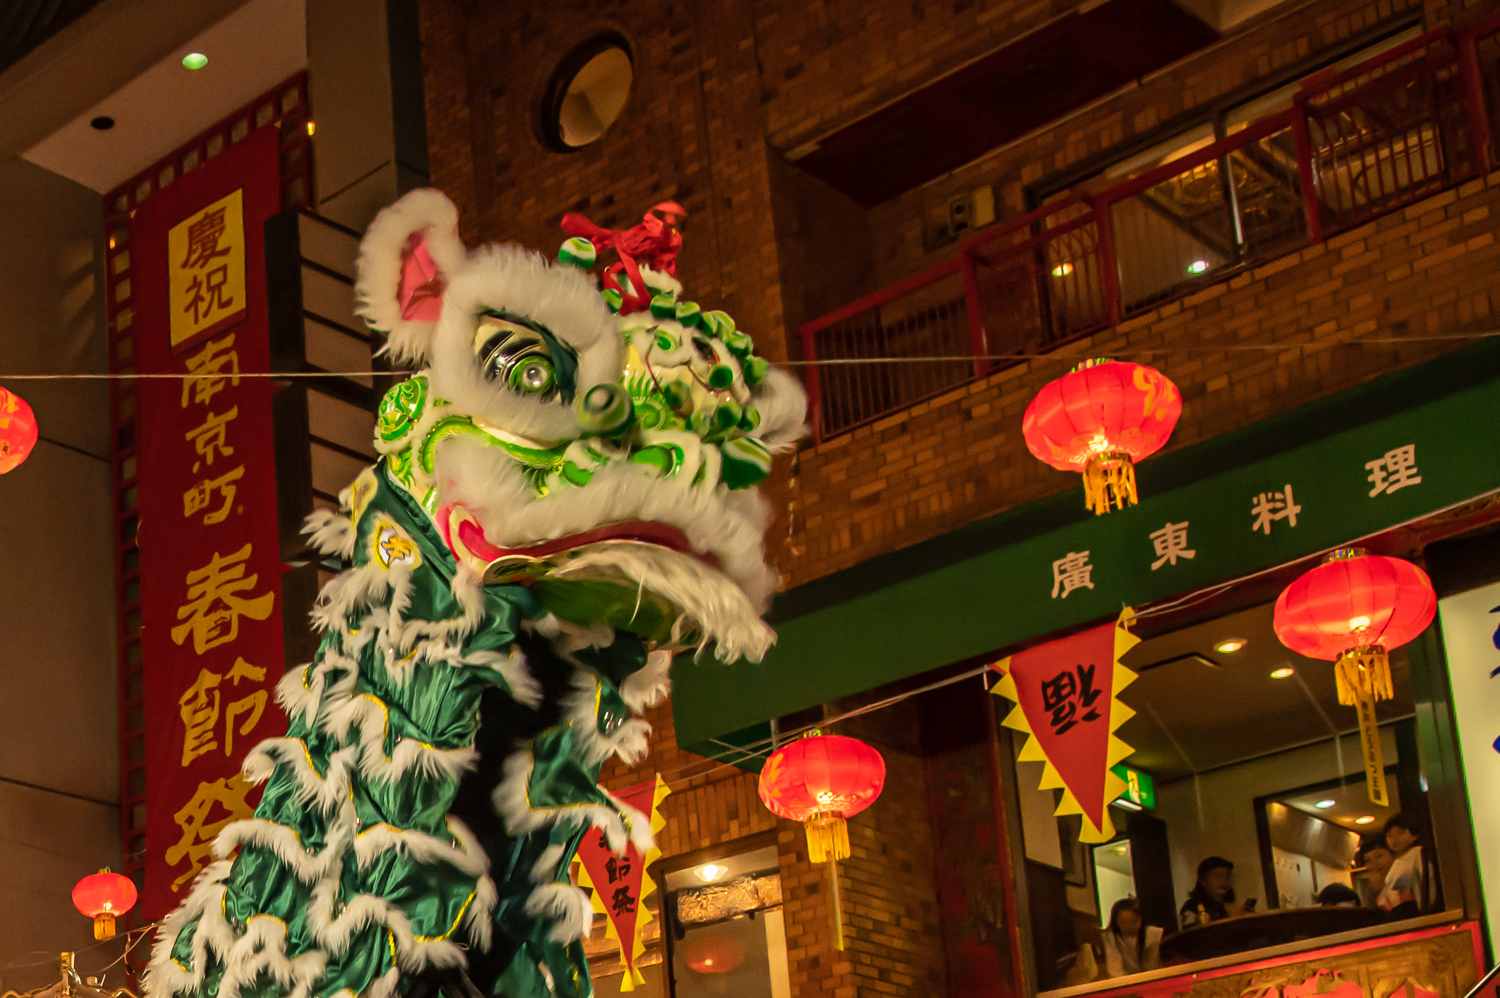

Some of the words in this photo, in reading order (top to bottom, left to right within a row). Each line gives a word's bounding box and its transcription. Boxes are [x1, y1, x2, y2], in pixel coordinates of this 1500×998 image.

[181, 206, 234, 325] 慶祝
[181, 332, 246, 526] 南京町
[1051, 443, 1422, 599] 廣東料理
[165, 542, 275, 893] 春節祭
[598, 835, 636, 917] 節祭
